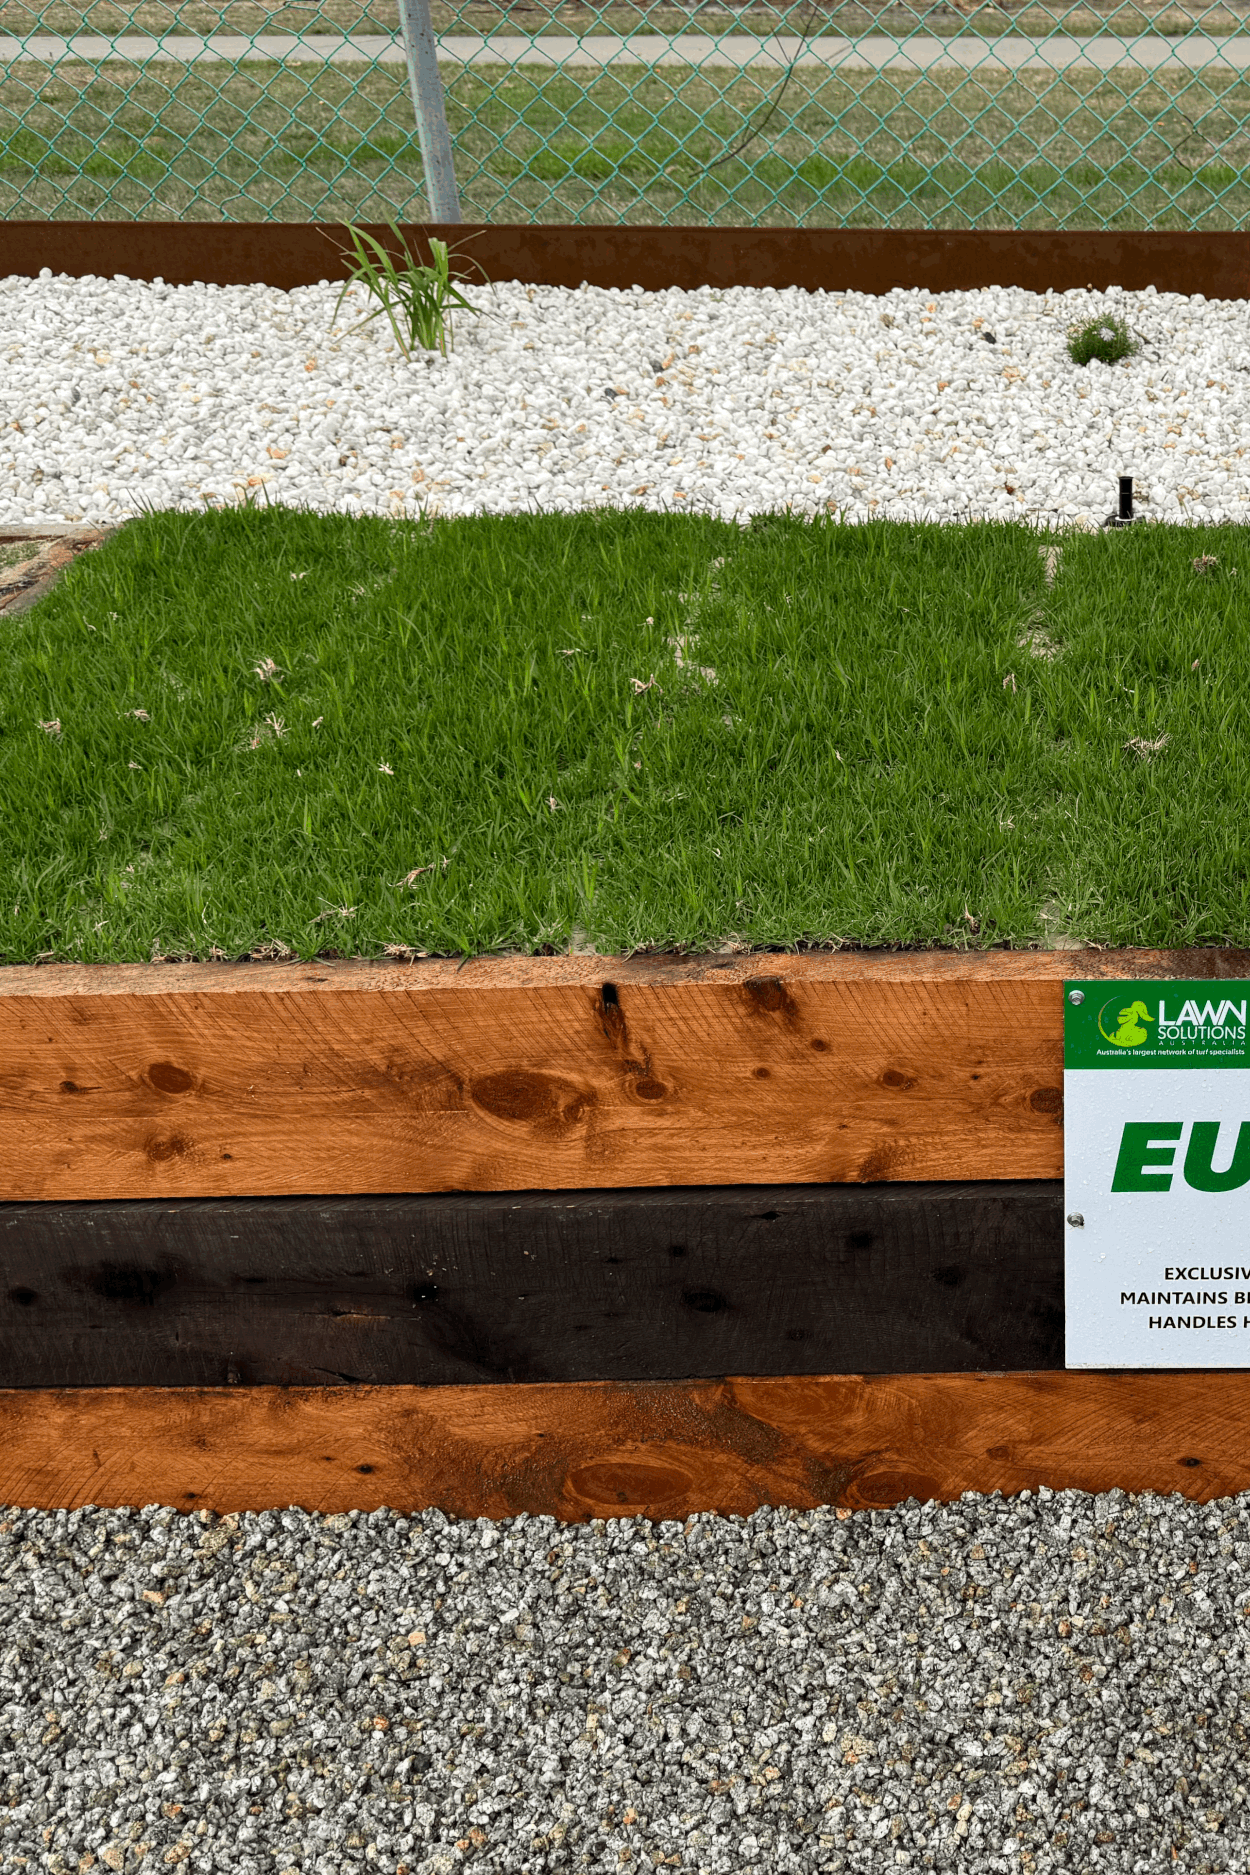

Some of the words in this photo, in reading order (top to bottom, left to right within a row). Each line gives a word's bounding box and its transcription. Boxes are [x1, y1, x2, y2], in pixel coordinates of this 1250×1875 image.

[1158, 999, 1247, 1026] LAWN
[1157, 1026, 1246, 1040] SOLUTIONS
[1209, 1048, 1245, 1056] specialists
[1120, 1291, 1228, 1305] MAINTAINS
[1148, 1316, 1237, 1329] HANDLES
